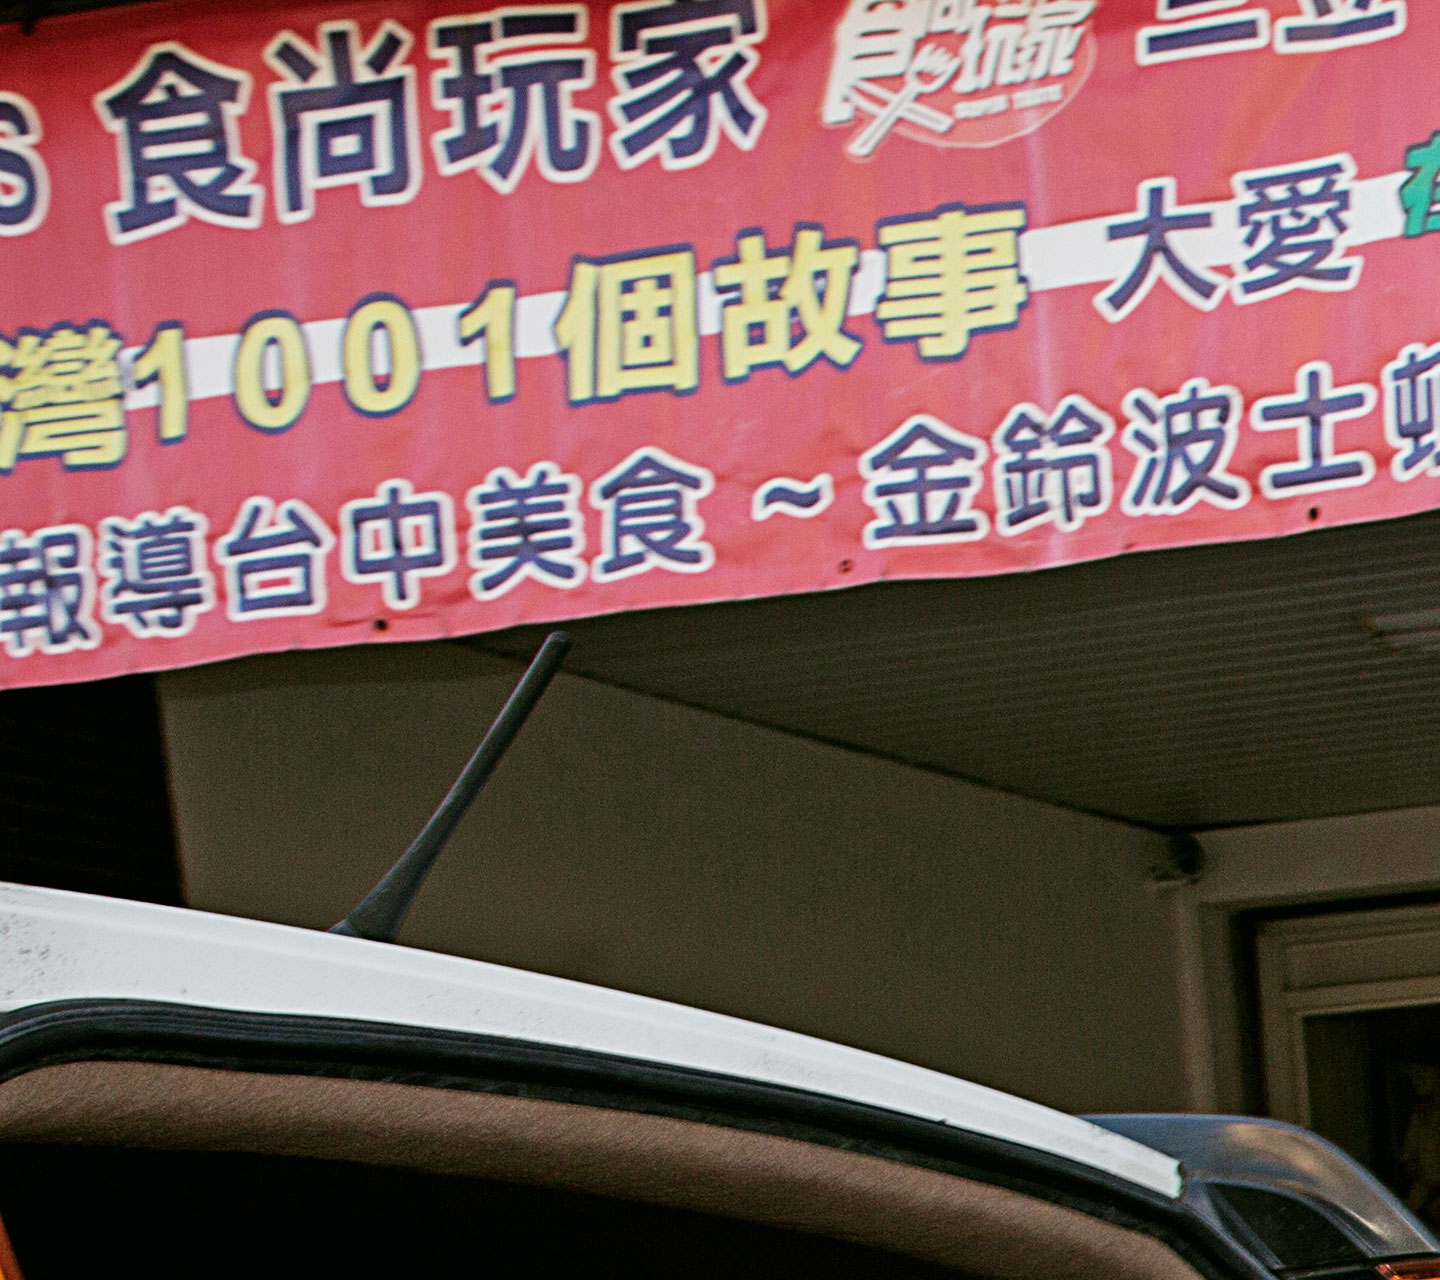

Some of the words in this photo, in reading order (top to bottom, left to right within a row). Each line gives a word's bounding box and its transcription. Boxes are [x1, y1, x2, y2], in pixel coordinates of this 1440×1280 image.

[104, 0, 764, 238] 食尚玩家
[1100, 160, 1358, 318] 大愛
